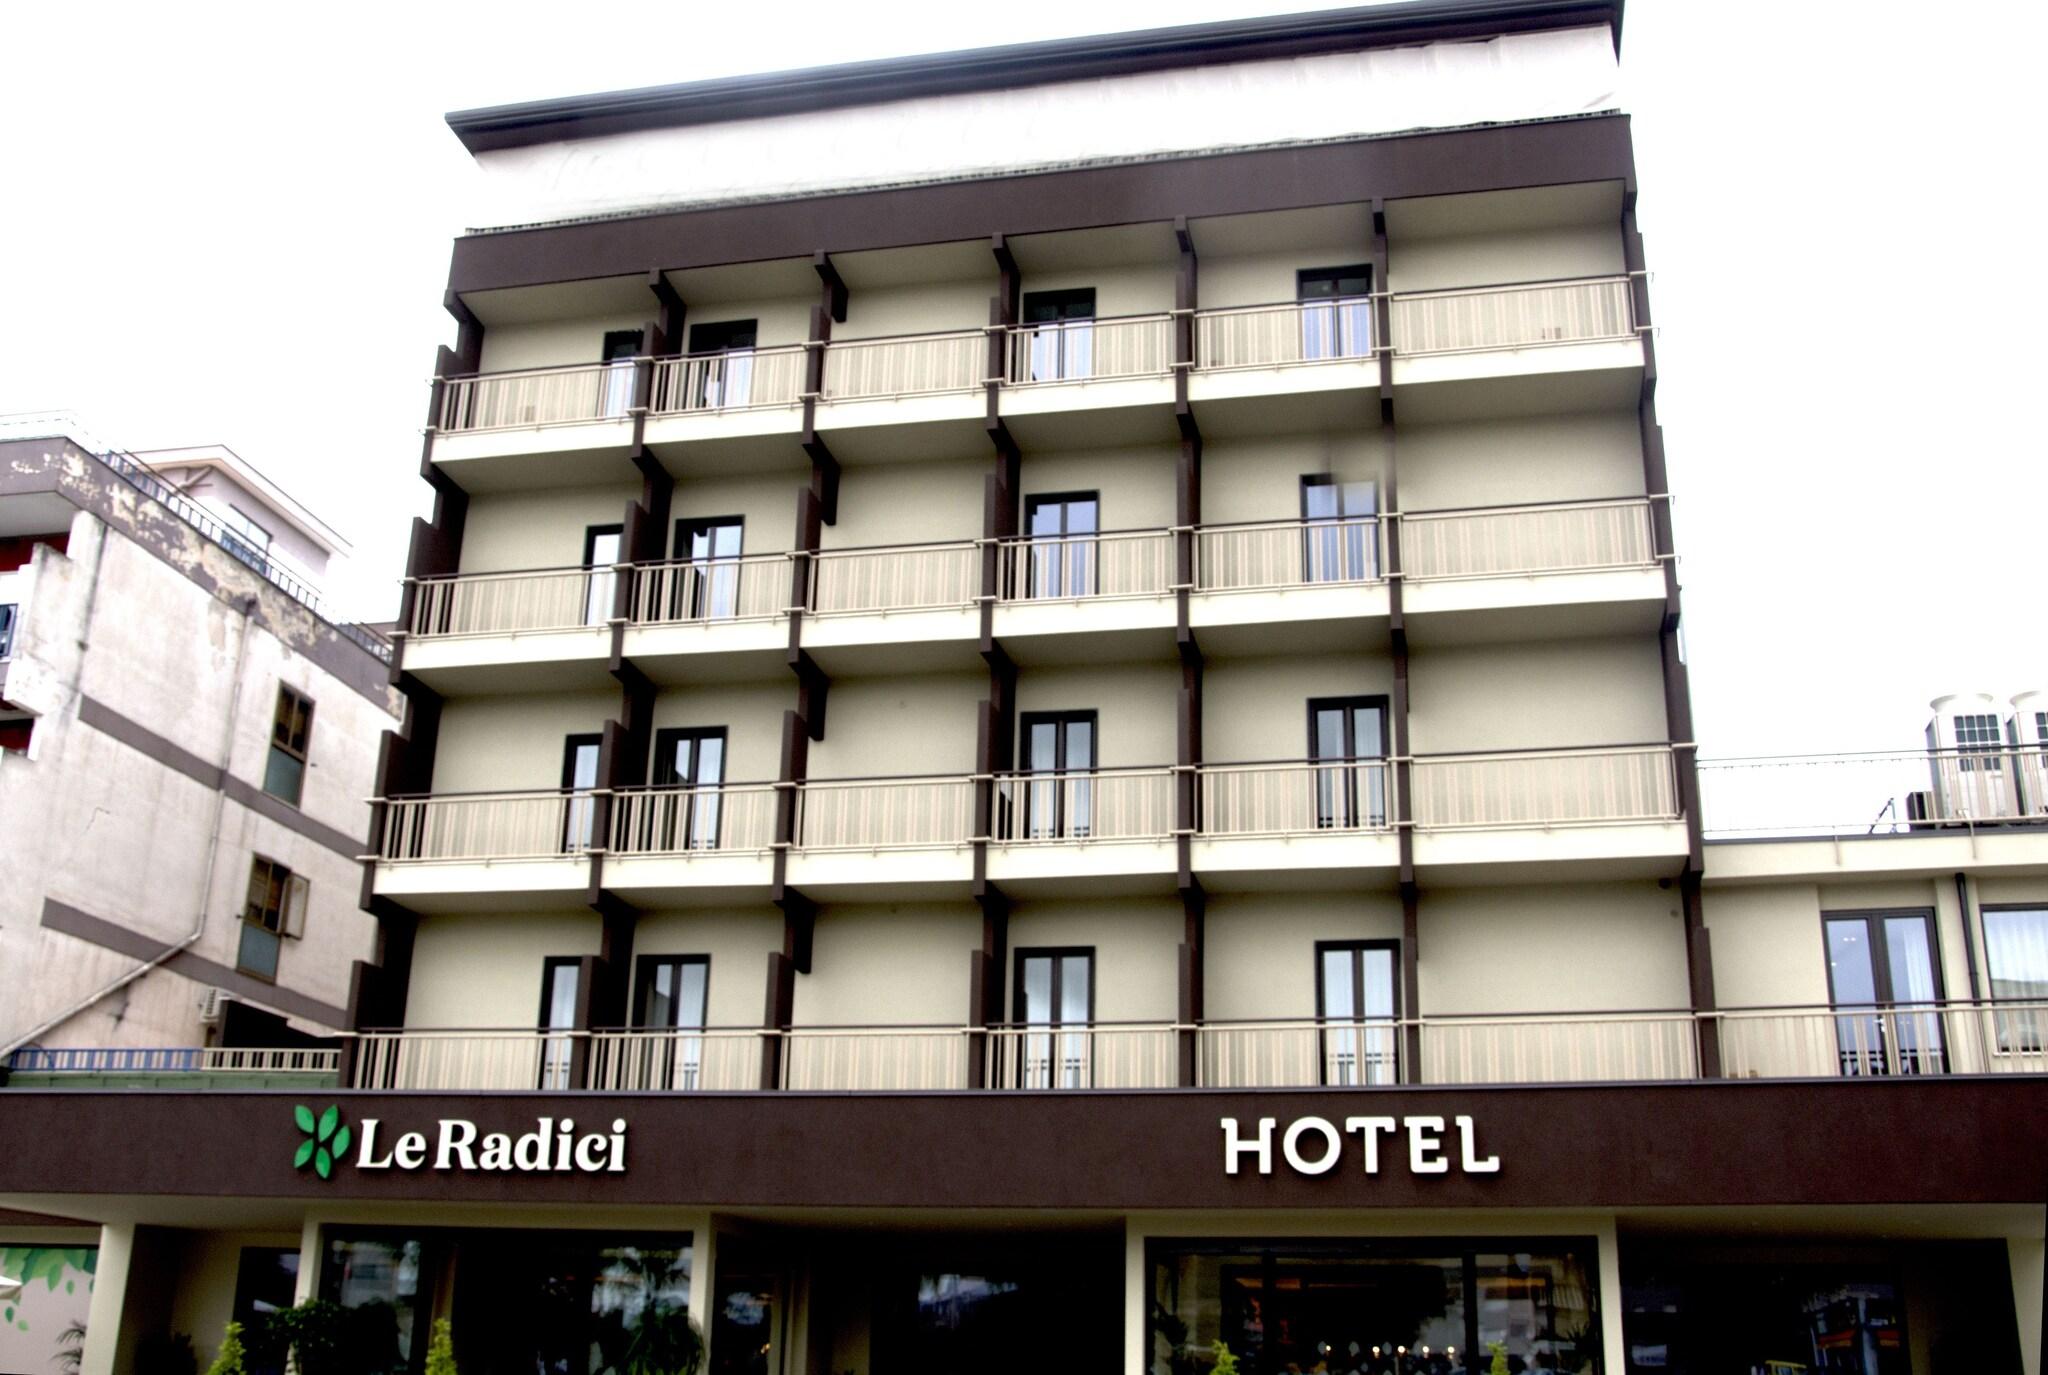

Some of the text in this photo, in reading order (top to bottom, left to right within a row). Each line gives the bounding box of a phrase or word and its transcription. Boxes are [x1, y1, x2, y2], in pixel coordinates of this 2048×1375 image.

[356, 1117, 627, 1172] Le Radici
[1220, 1115, 1500, 1175] HOTEL
